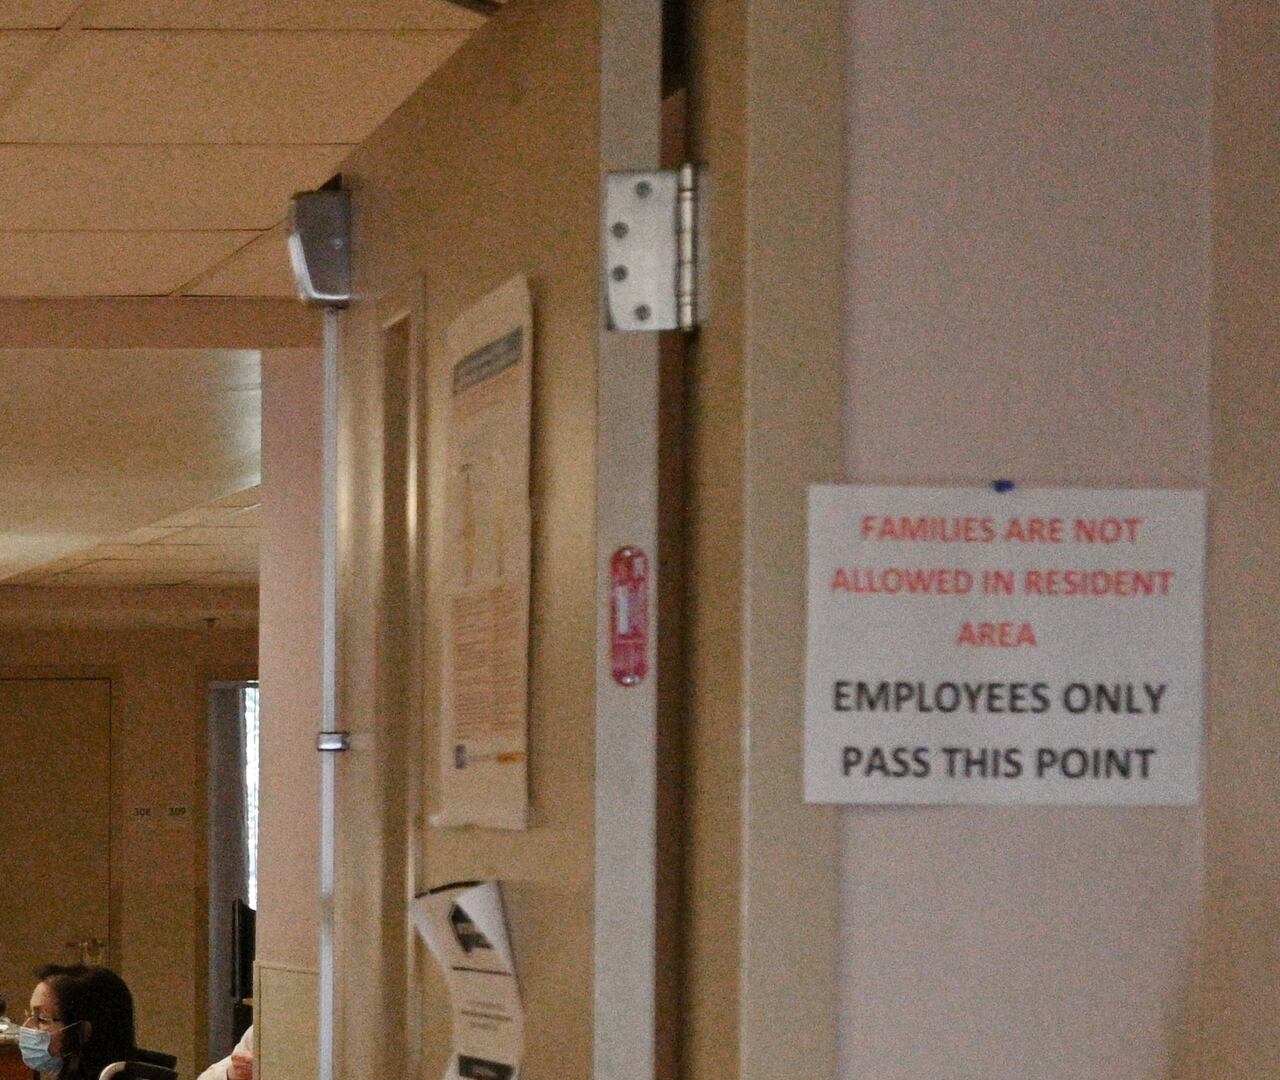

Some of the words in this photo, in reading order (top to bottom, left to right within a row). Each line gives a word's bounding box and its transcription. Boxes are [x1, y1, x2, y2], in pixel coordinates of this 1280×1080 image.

[861, 515, 996, 544] FAMILIES
[1005, 517, 1063, 544] ARE
[1074, 518, 1144, 544] NOT
[830, 567, 974, 596] ALLOWED
[983, 568, 1015, 596] IN
[1025, 569, 1174, 598] RESIDENT
[956, 621, 1038, 649] AREA
[834, 680, 1051, 714] EMPLOYEES
[1062, 682, 1168, 714] ONLY
[842, 745, 932, 778] PASS
[941, 746, 1024, 779] THIS
[1036, 747, 1157, 780] POINT
